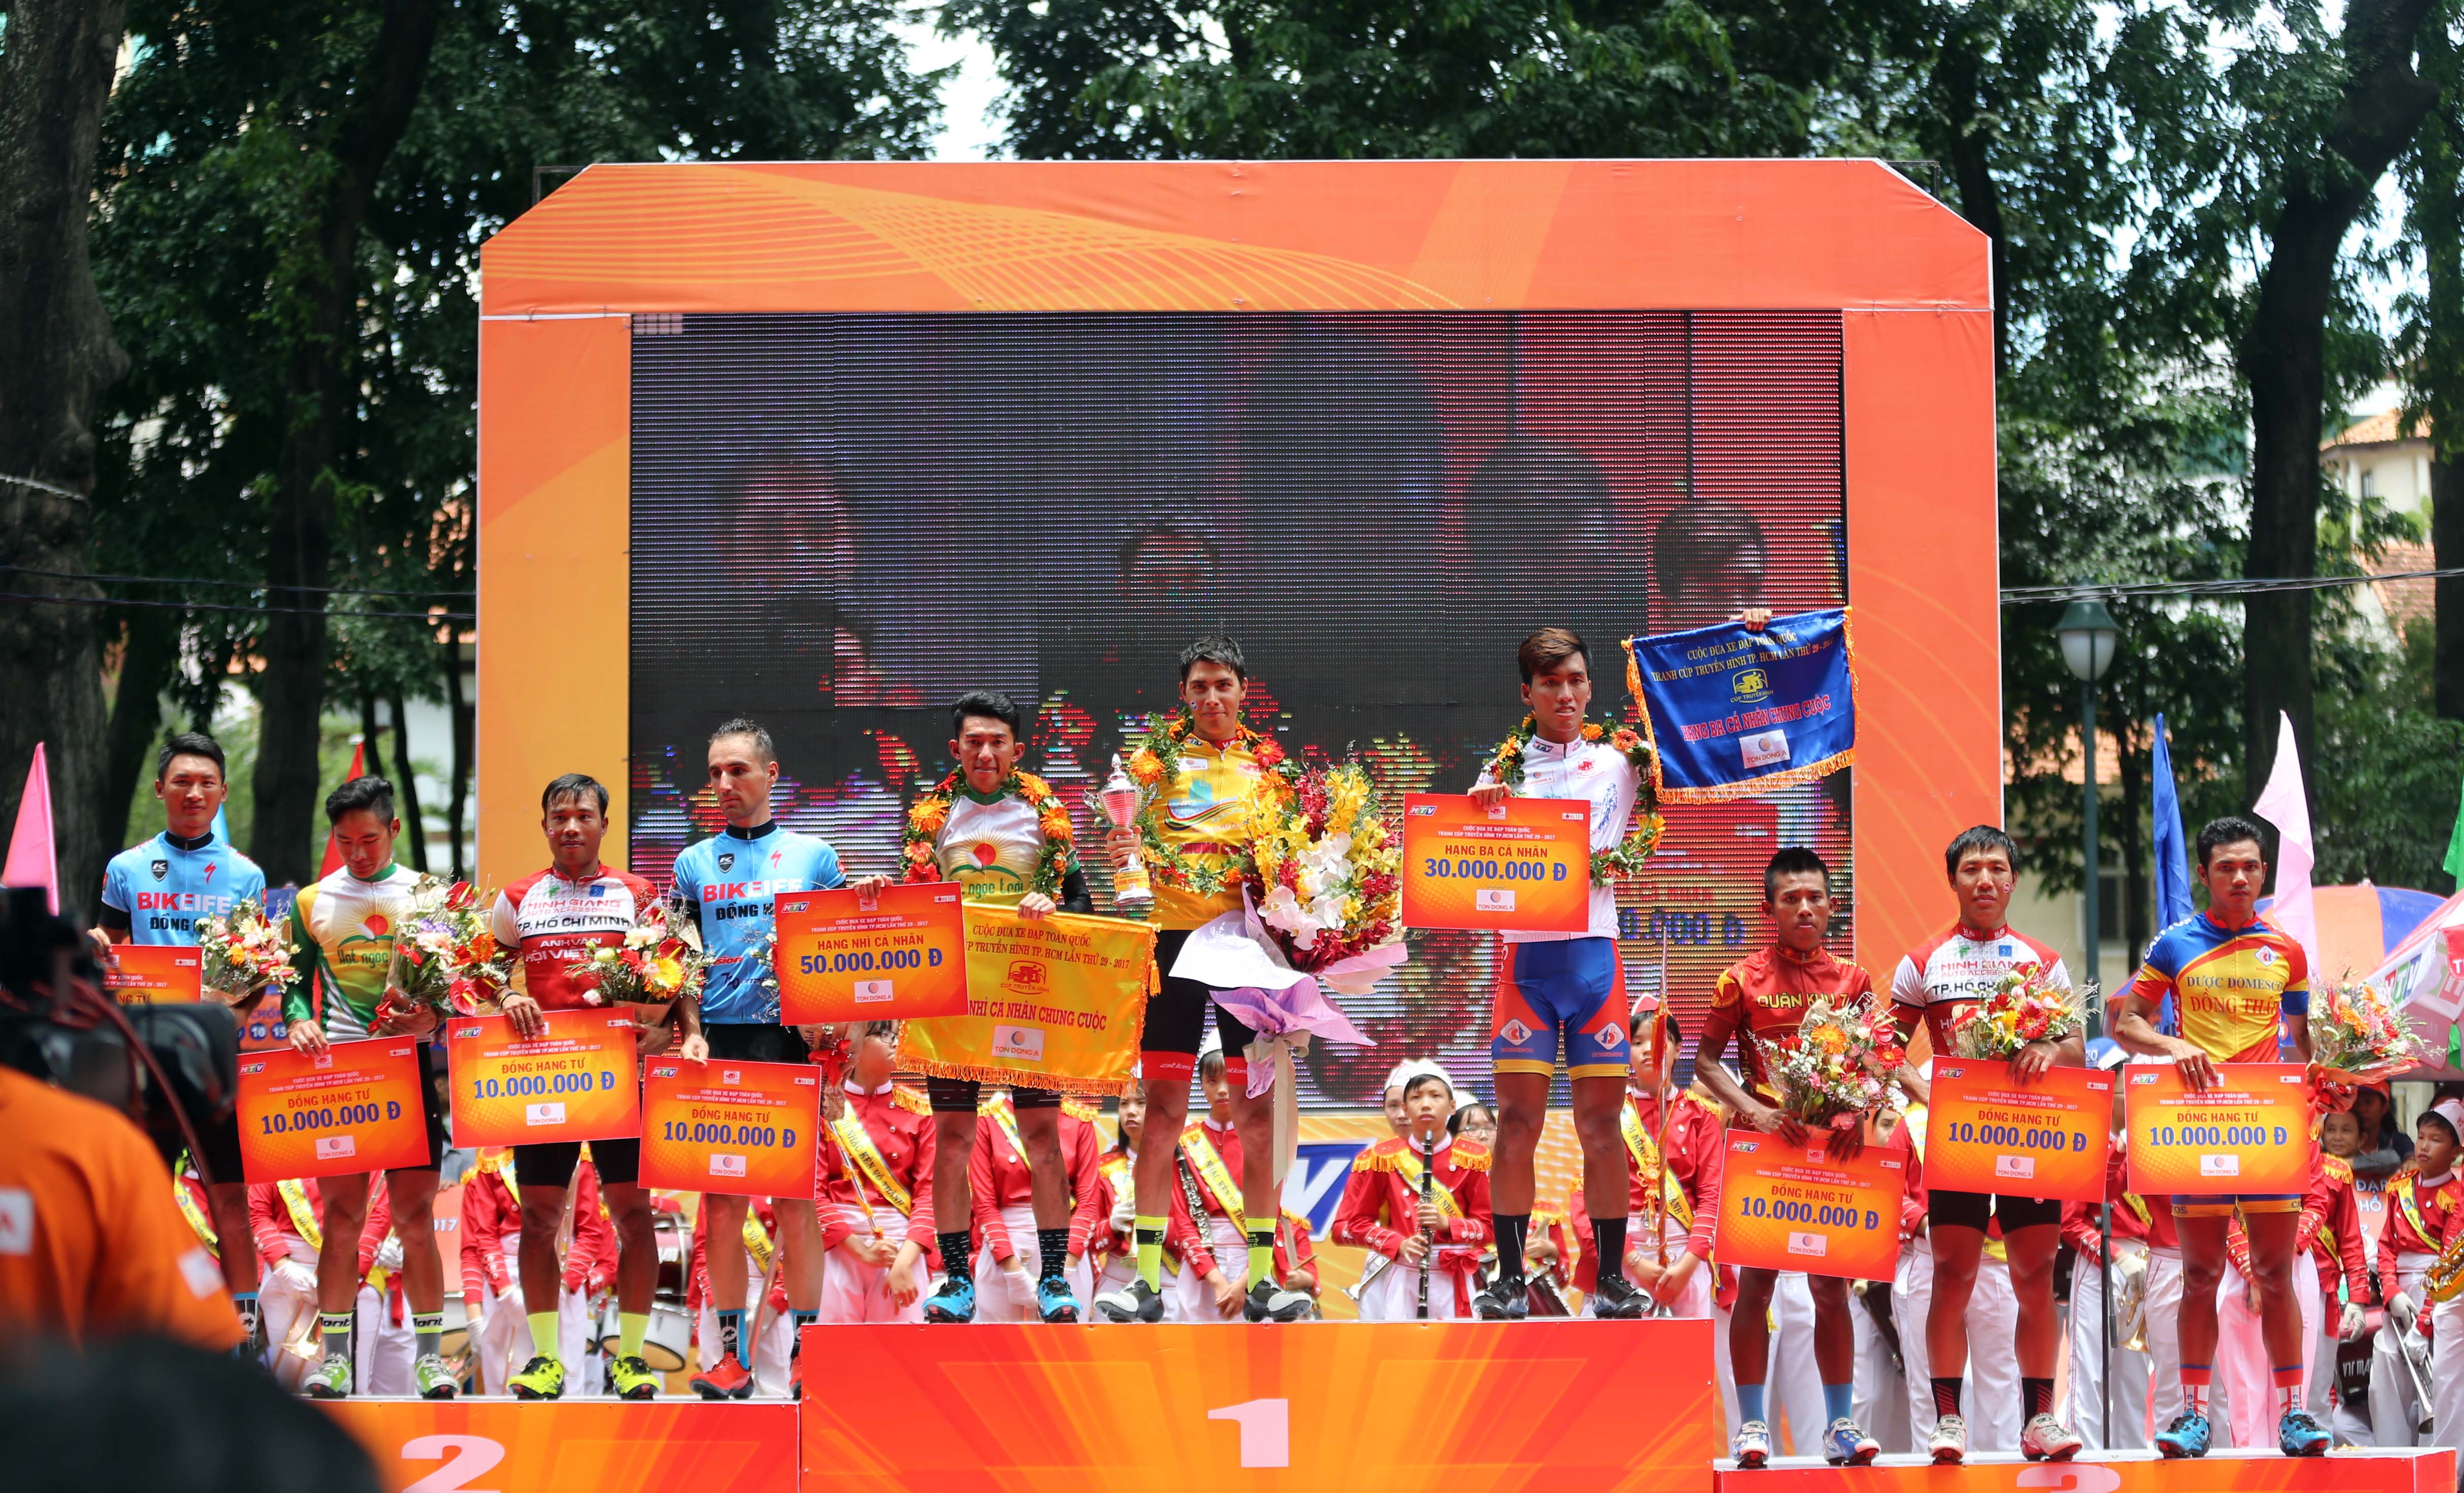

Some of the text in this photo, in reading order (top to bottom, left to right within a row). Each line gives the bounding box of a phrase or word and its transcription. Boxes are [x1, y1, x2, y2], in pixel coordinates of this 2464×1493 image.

[1687, 629, 1798, 661] CUỘC ĐUA XE ĐẠP TOÀN QUỐC
[1651, 670, 1677, 682] TRANH
[1679, 665, 1693, 678] CÚP
[1695, 658, 1726, 676] TRUYỀN
[1727, 655, 1747, 670] HÌNH
[1748, 655, 1758, 666] TP.
[1760, 650, 1777, 662] HCM
[1796, 640, 1811, 657] THỨ
[1811, 644, 1818, 653] 29
[1680, 694, 1831, 745] HẠNG BA CÁ NHÂN CHUNG CUỘC
[1533, 741, 1553, 752] HTV
[1762, 752, 1780, 760] DONG
[1410, 806, 1436, 815] HTV
[1445, 844, 1548, 858] HẠNG BA CÁ NHÂN
[1424, 858, 1567, 882] 30.000.000 Đ
[527, 900, 566, 908] MINH
[782, 903, 808, 912] HTV
[150, 914, 189, 931] ĐỒNG
[518, 923, 532, 932] TP.
[561, 915, 586, 927] CHÍ
[589, 917, 630, 926] MINH
[540, 938, 570, 948] ANH
[817, 933, 924, 953] HẠNG NHÌ CÁ NHÂN
[973, 924, 1091, 947] CUỘC ĐUA XE ĐẠP TOÀN QUỐC
[800, 948, 942, 974] 50.000.000 Đ
[965, 938, 973, 951] ÚP
[975, 938, 1008, 954] TRUYỀN
[1009, 941, 1030, 955] HÌNH
[1032, 946, 1043, 957] TP.
[1045, 949, 1063, 960] HCM
[1083, 953, 1099, 965] THỨ
[1100, 957, 1109, 966] 29
[1113, 959, 1130, 969] 2017
[1933, 982, 1952, 995] TP.
[2187, 975, 2283, 992] DƯỢC DOMESCO
[1757, 991, 1803, 1010] QUÂN
[1840, 994, 1848, 1007] 7
[2190, 988, 2236, 1013] ĐỒNG
[969, 996, 1107, 1034] NHÌ CÁ NHÂN CHUNG CUỘC
[455, 1028, 481, 1038] HTV
[1011, 1047, 1032, 1055] DONG
[502, 1058, 585, 1074] ĐỒNG HẠNG TƯ
[652, 1068, 677, 1077] HTV
[474, 1071, 615, 1099] 10.000.000 Đ
[2131, 1074, 2157, 1084] HTV
[692, 1105, 771, 1123] ĐỒNG HẠNG TƯ
[2177, 1108, 2259, 1124] ĐỒNG HẠNG TƯ
[664, 1121, 796, 1148] 10.000.000 Đ
[2150, 1126, 2287, 1146] 10.000.000 Đ
[1731, 1142, 1758, 1152] HTV
[1771, 1182, 1854, 1204] ĐỒNG HẠNG TƯ
[1741, 1197, 1879, 1230] 10.000.000 Đ
[1208, 1398, 1289, 1467] 1
